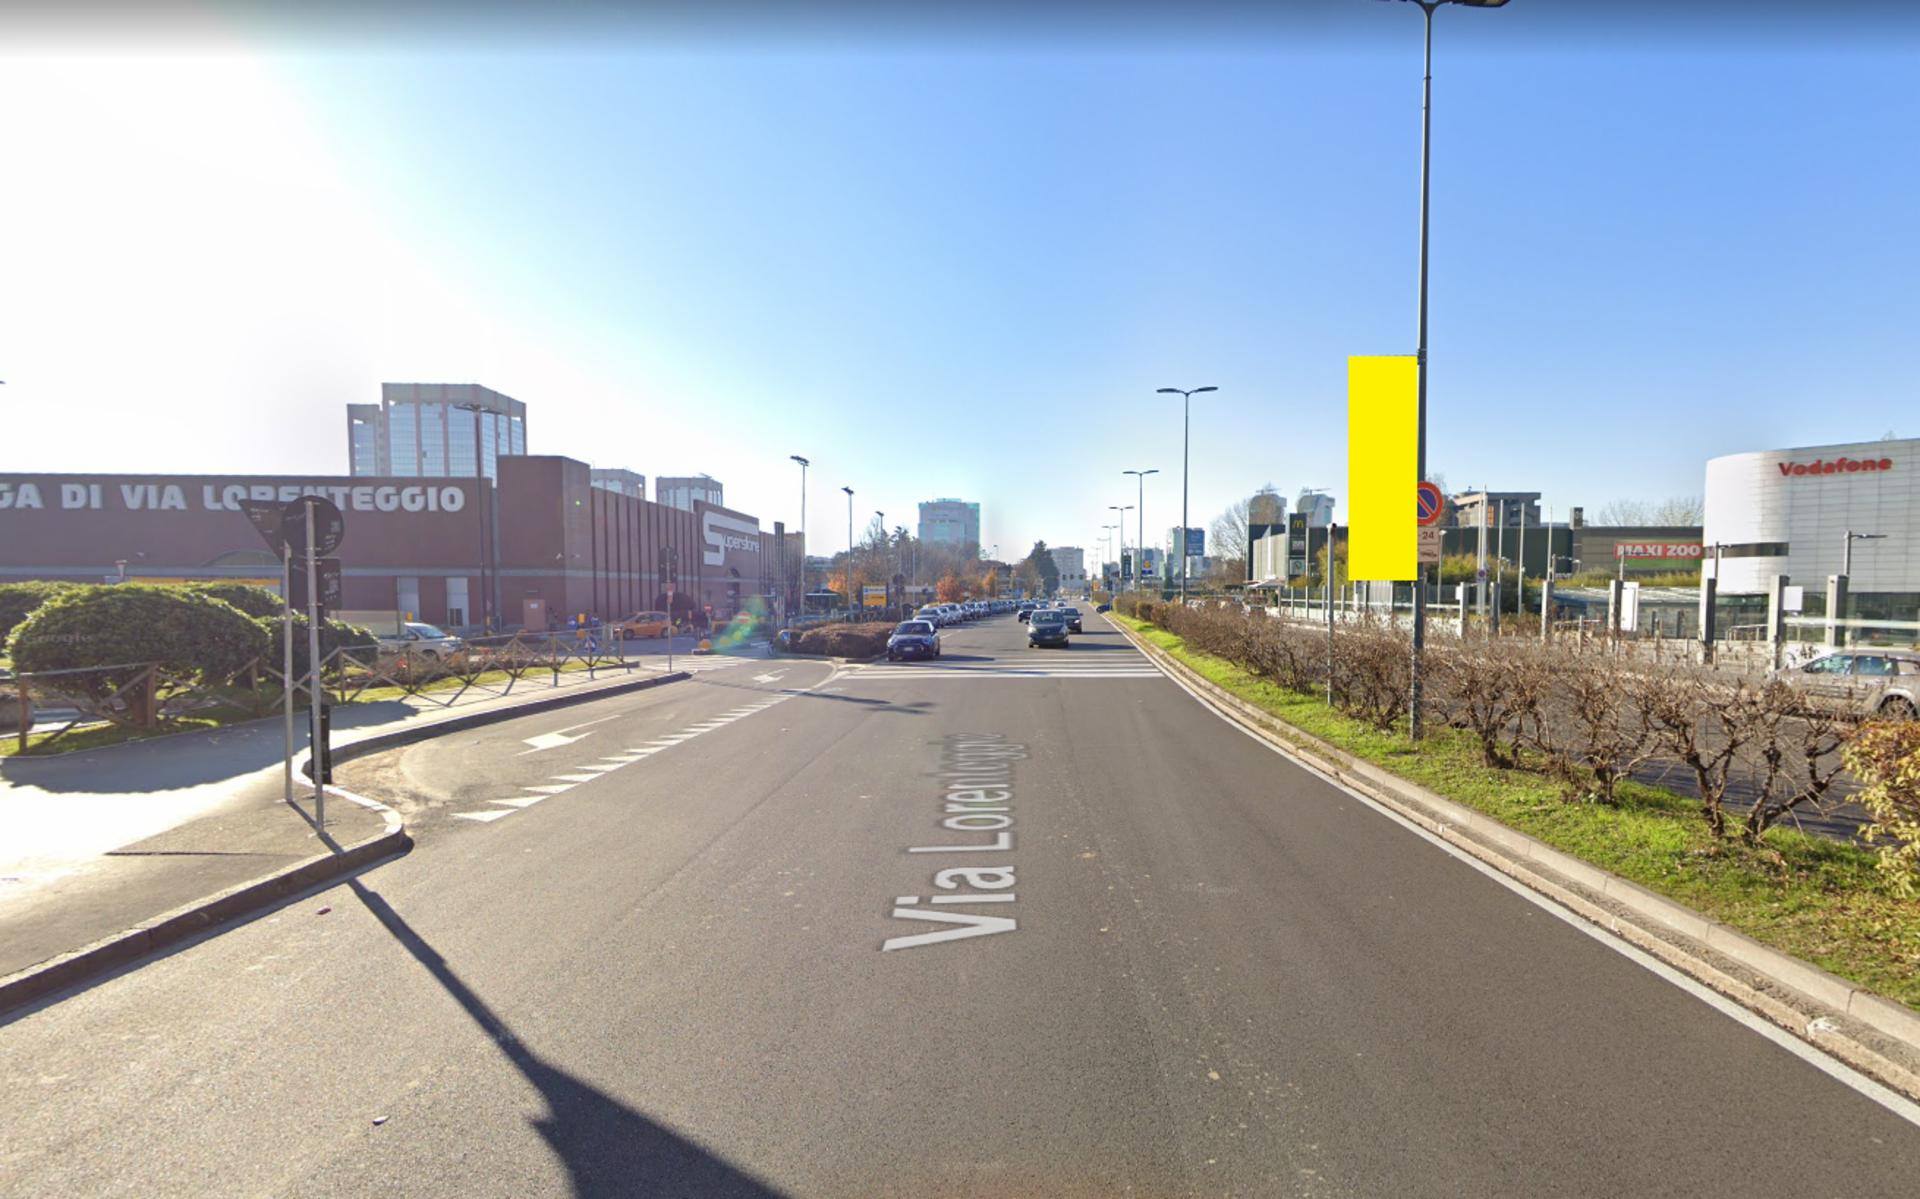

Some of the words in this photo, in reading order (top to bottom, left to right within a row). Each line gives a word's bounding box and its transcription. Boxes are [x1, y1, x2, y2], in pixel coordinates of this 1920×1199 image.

[1778, 457, 1892, 476] Vodafone
[61, 484, 103, 509] DI
[120, 484, 188, 510] VIA
[1617, 545, 1663, 557] MAXI
[1666, 545, 1700, 557] ZOO
